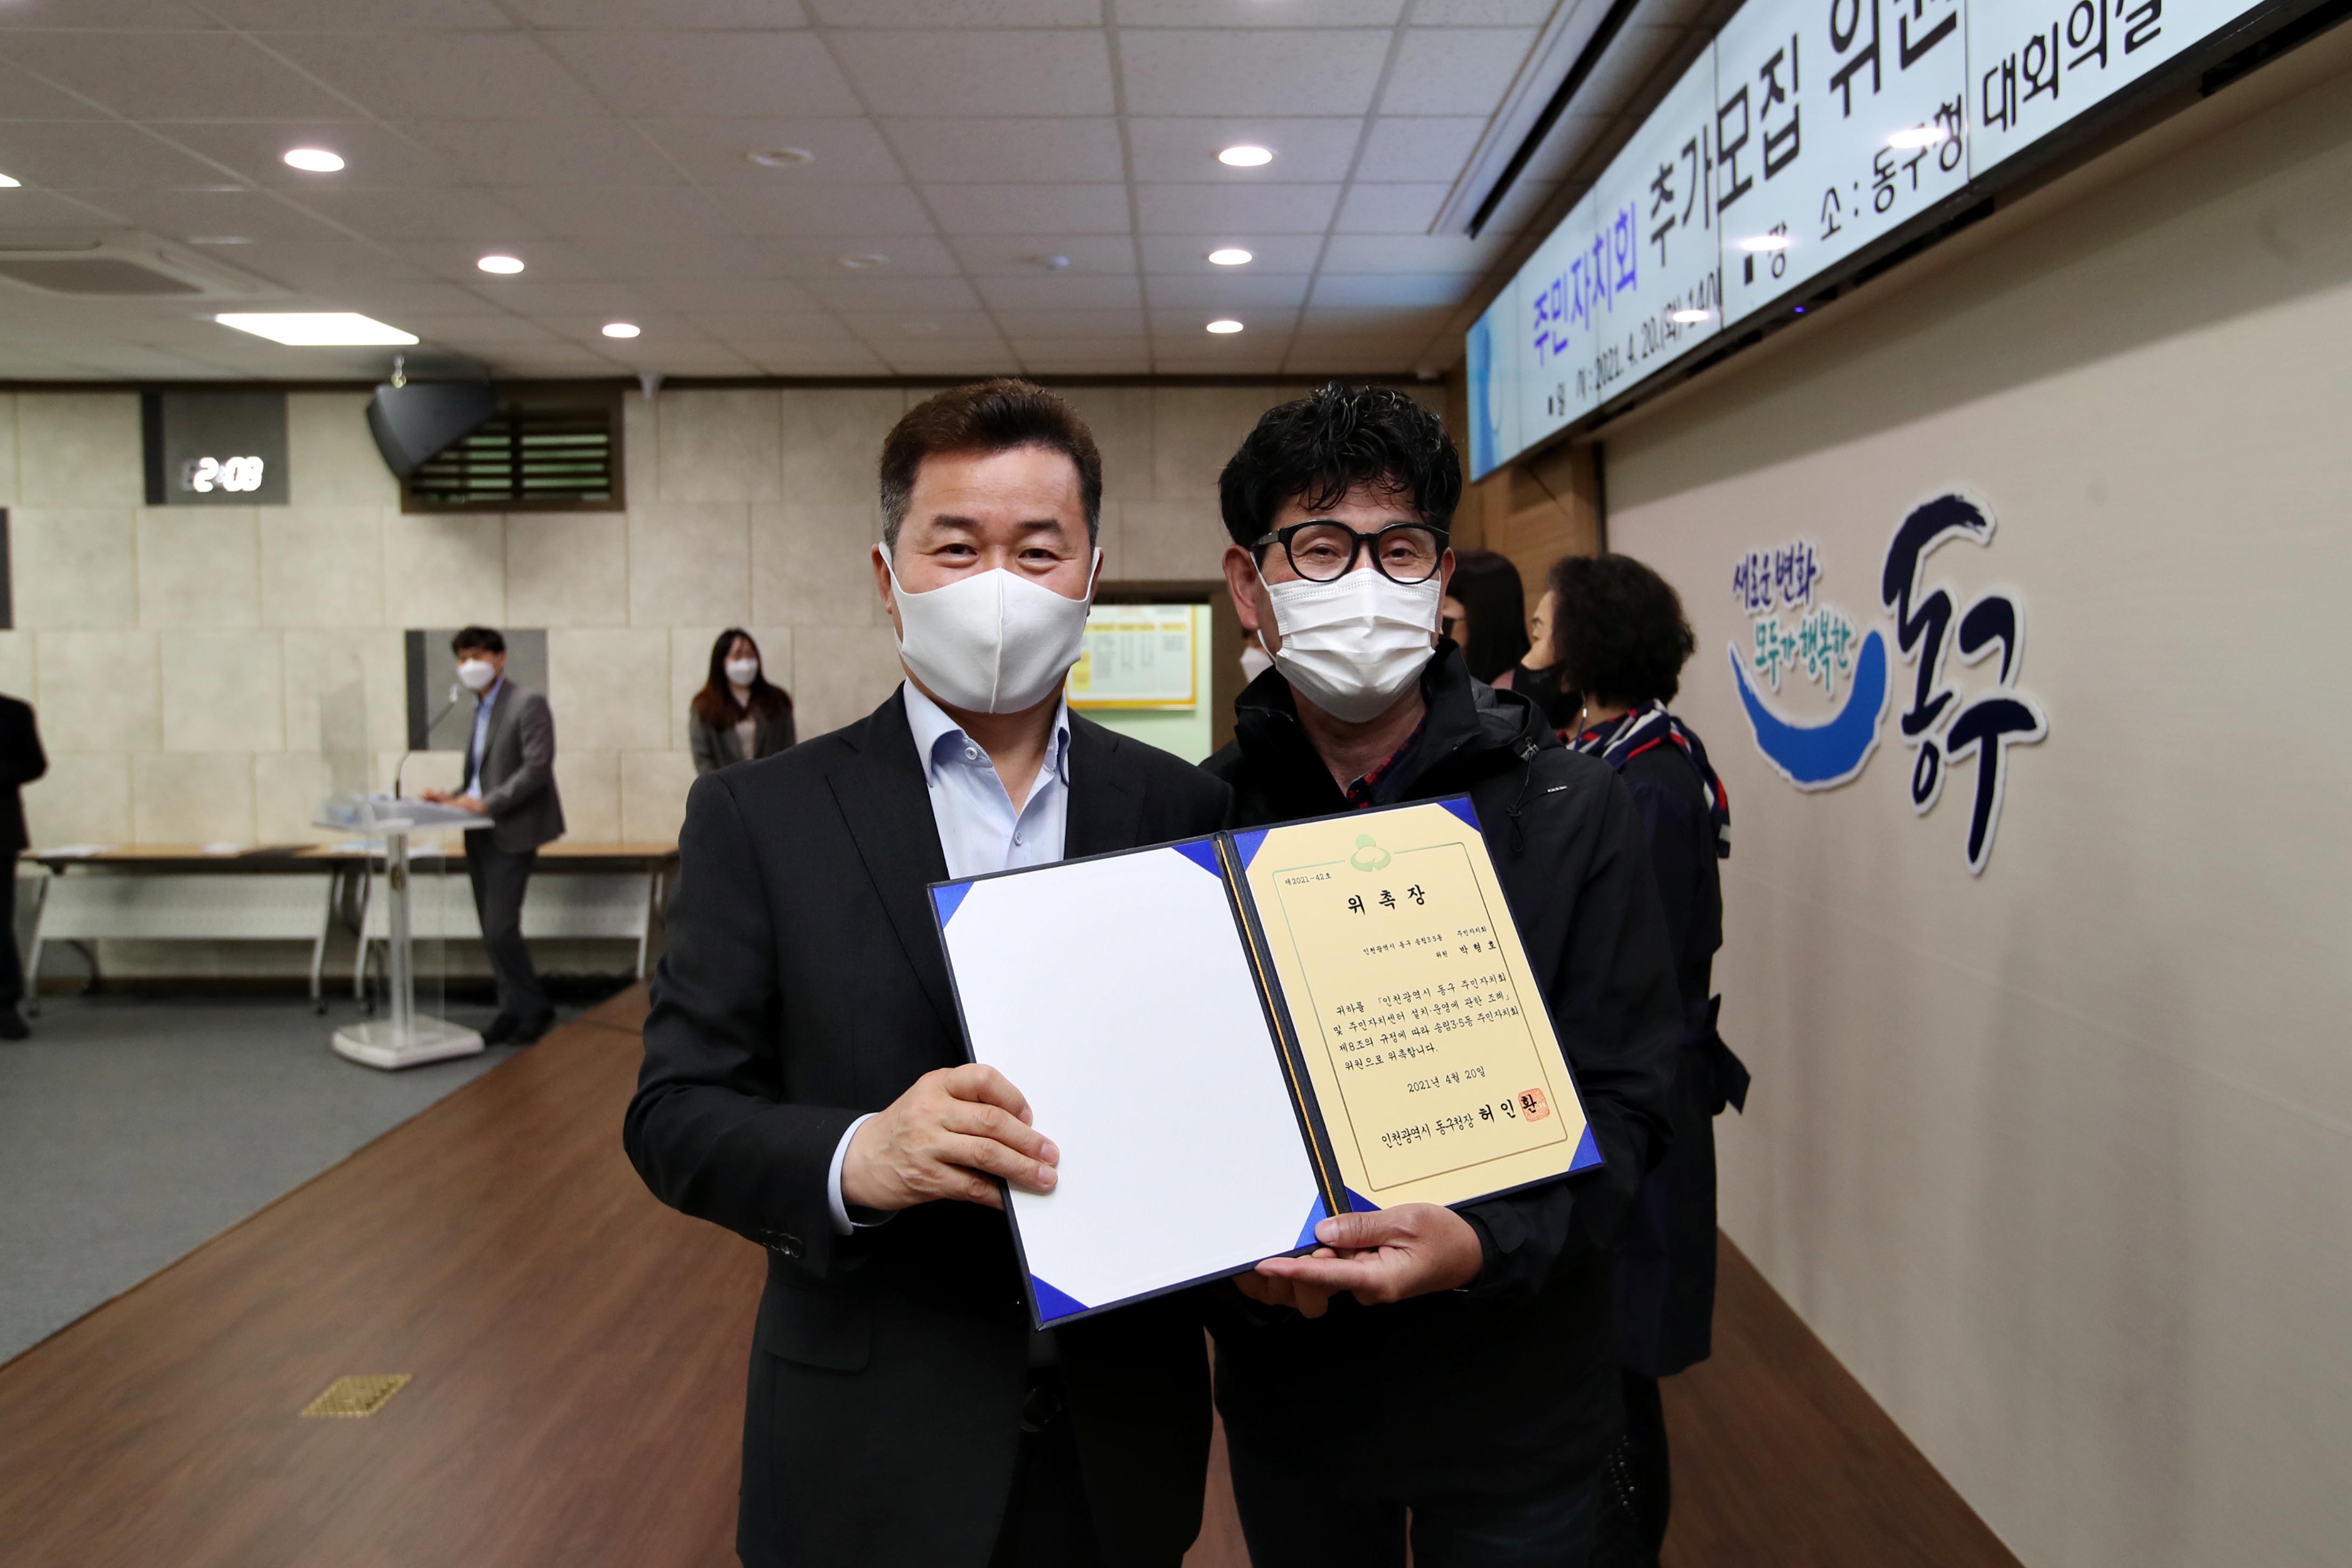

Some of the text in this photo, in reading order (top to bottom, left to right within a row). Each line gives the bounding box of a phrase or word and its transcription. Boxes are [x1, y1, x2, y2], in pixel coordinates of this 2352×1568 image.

[1534, 201, 1637, 367] 주민자치회
[1649, 32, 1801, 268] 추가모집
[193, 456, 264, 492] 2:08
[1733, 540, 1816, 610] 새로운 변화
[1755, 609, 1851, 691] 모두가 행복한
[1362, 942, 1395, 955] 인천광역시
[1399, 939, 1411, 949] 동구
[1457, 925, 1487, 937] 주민자치회
[1436, 950, 1448, 958] 위원
[1336, 1001, 1364, 1016] 귀하를
[1437, 982, 1455, 996] 동구
[1461, 972, 1507, 990] 주민자치회
[1333, 1024, 1343, 1036] 및
[1348, 1011, 1405, 1032] 주민자치센터
[1464, 995, 1482, 1009] 관한
[1339, 1037, 1374, 1053] 제8조의
[1380, 1029, 1407, 1044] 규정에
[1411, 1025, 1430, 1037] 따라
[1477, 1005, 1519, 1023] 주민자치회
[1345, 1042, 1438, 1070] 위원으로 위촉합니다.
[1406, 1065, 1486, 1093] 2021년 4월 20일
[1381, 1123, 1431, 1149] 인천광역시
[1435, 1112, 1474, 1136] 동구청장
